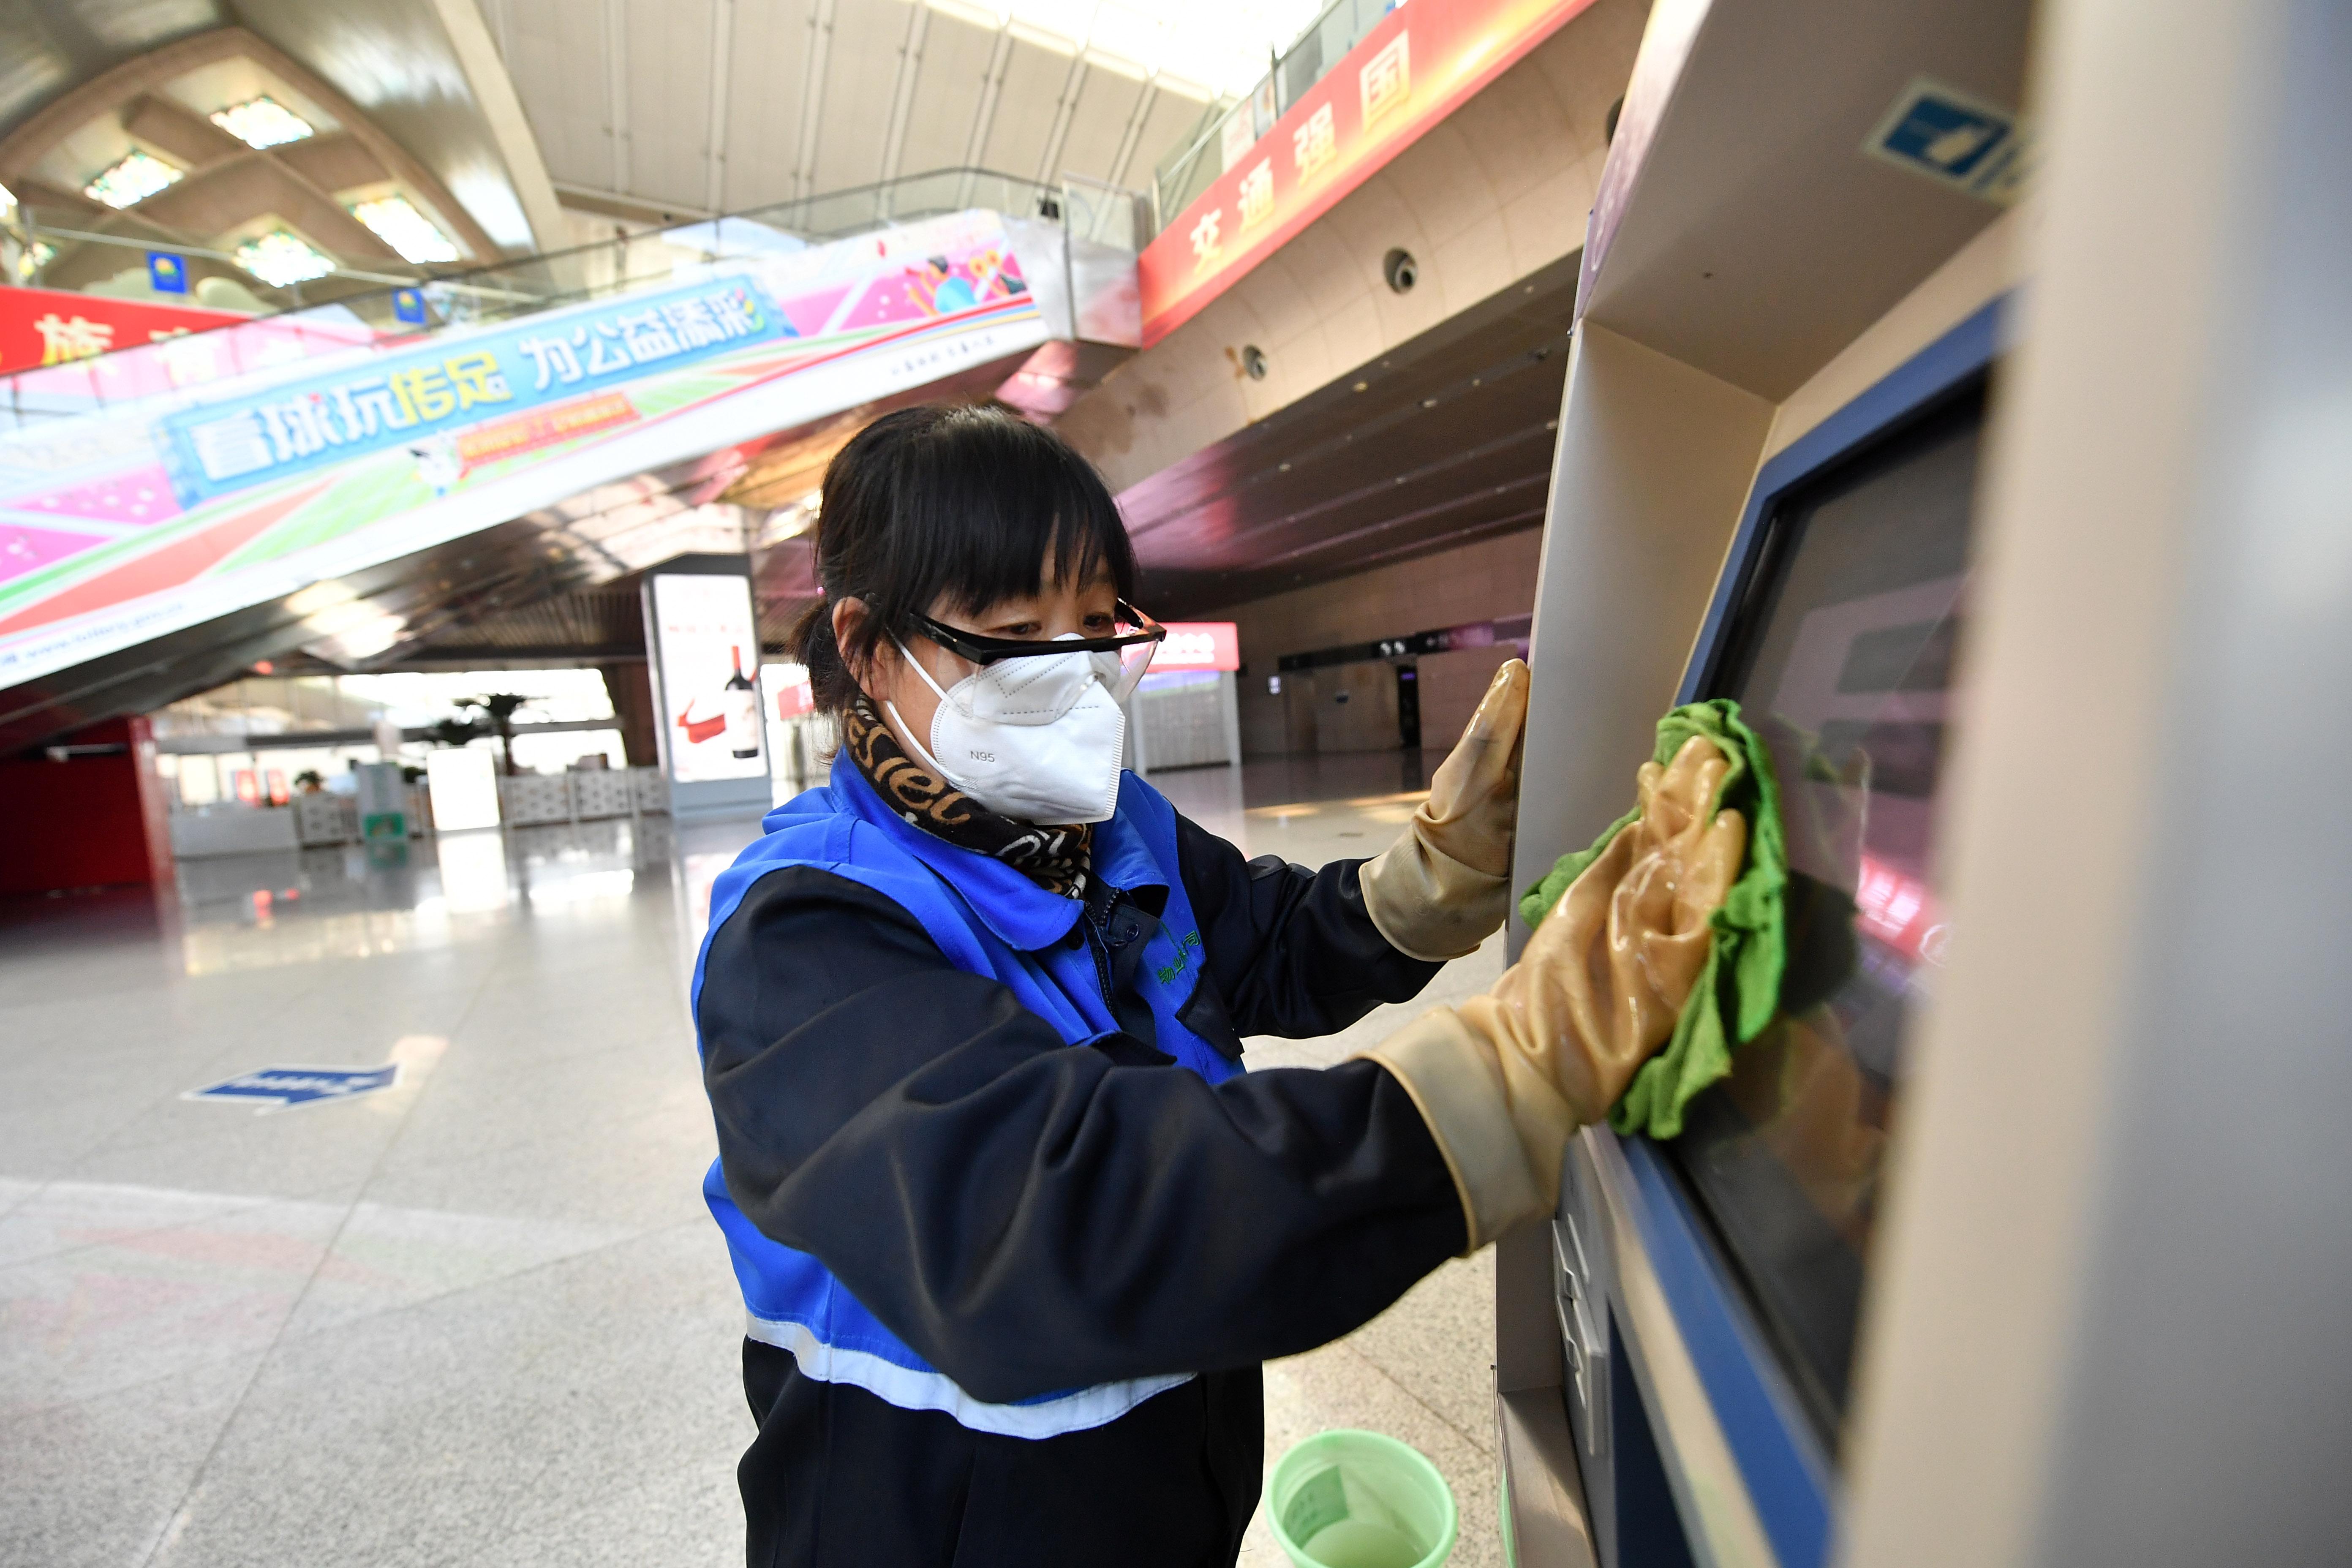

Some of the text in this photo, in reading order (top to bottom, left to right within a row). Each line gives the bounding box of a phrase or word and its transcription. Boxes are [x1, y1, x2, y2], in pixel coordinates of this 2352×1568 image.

[1190, 29, 1410, 275] 交通强国
[970, 751, 995, 762] N95
